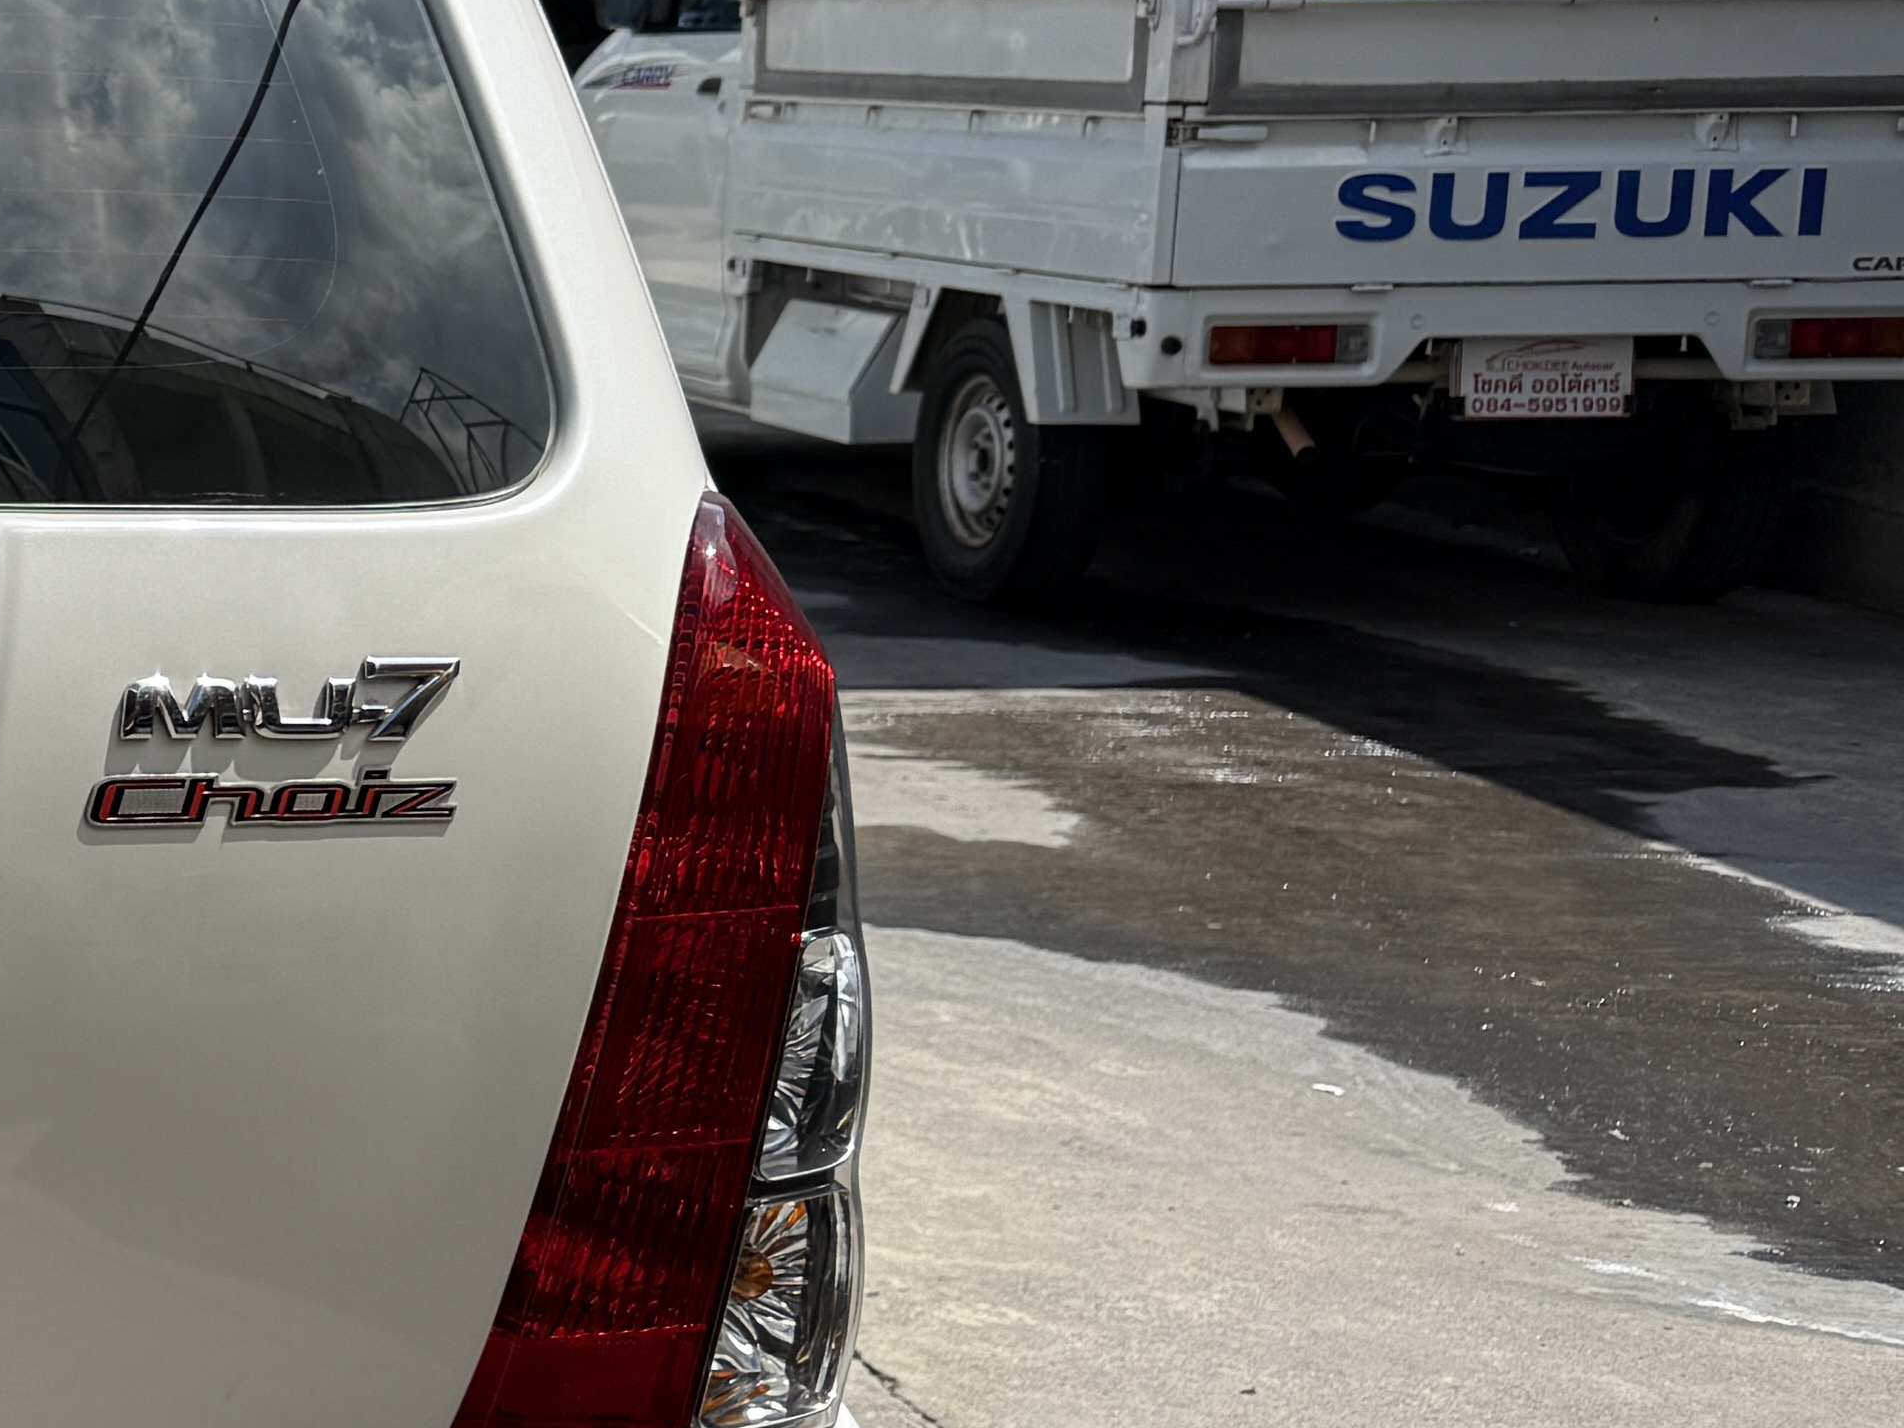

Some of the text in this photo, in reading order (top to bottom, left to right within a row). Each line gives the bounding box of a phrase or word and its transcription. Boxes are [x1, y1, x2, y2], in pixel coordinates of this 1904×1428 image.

[1335, 167, 1829, 242] SUZUKI
[1473, 372, 1524, 395] โชคดี
[1471, 396, 1622, 414] 084-5951999
